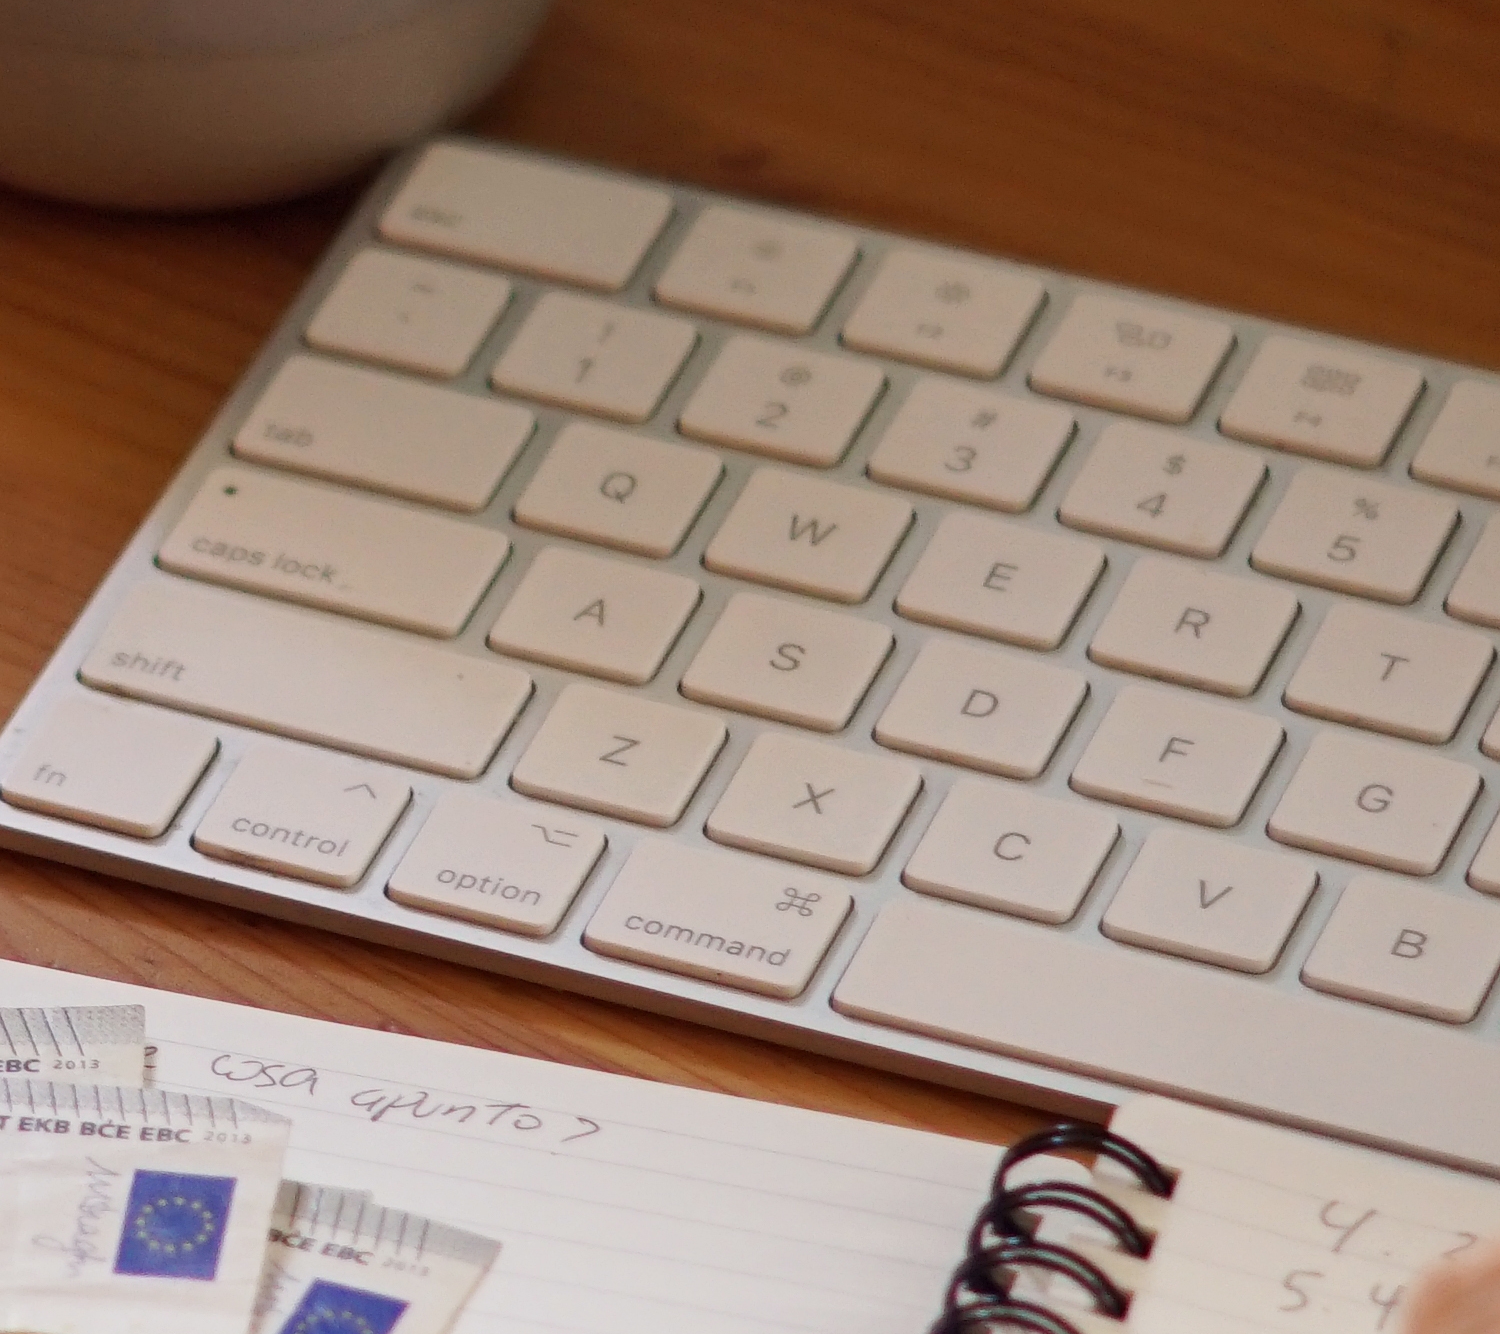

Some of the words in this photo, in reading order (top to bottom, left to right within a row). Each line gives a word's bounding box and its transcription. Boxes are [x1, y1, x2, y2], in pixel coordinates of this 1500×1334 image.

[576, 357, 595, 383] 1
[755, 402, 790, 429] 2
[263, 420, 315, 448] tab
[944, 445, 979, 473] 3
[598, 471, 638, 504] Q
[1136, 492, 1168, 518] 4
[788, 513, 838, 547] W
[191, 536, 266, 565] caps
[271, 552, 337, 583] lock
[1327, 534, 1361, 563] 5
[982, 561, 1017, 592] E
[573, 597, 606, 627] A
[1174, 606, 1212, 639] R
[111, 651, 185, 681] shift
[769, 642, 806, 672] S
[1380, 652, 1410, 682] T
[960, 688, 1000, 719] D
[599, 734, 641, 767] Z
[1158, 736, 1195, 763] F
[33, 763, 67, 786] fn
[793, 782, 835, 815] X
[1355, 783, 1395, 814] G
[230, 816, 351, 858] control
[992, 831, 1032, 862] C
[435, 868, 543, 907] option
[1198, 879, 1234, 910] V
[623, 915, 792, 967] command
[1390, 928, 1429, 960] B
[52, 1058, 101, 1070] 2013
[17, 1116, 70, 1135] EKB
[138, 1125, 192, 1144] EBC
[203, 1130, 253, 1145] 2013
[319, 1242, 375, 1266] EBC
